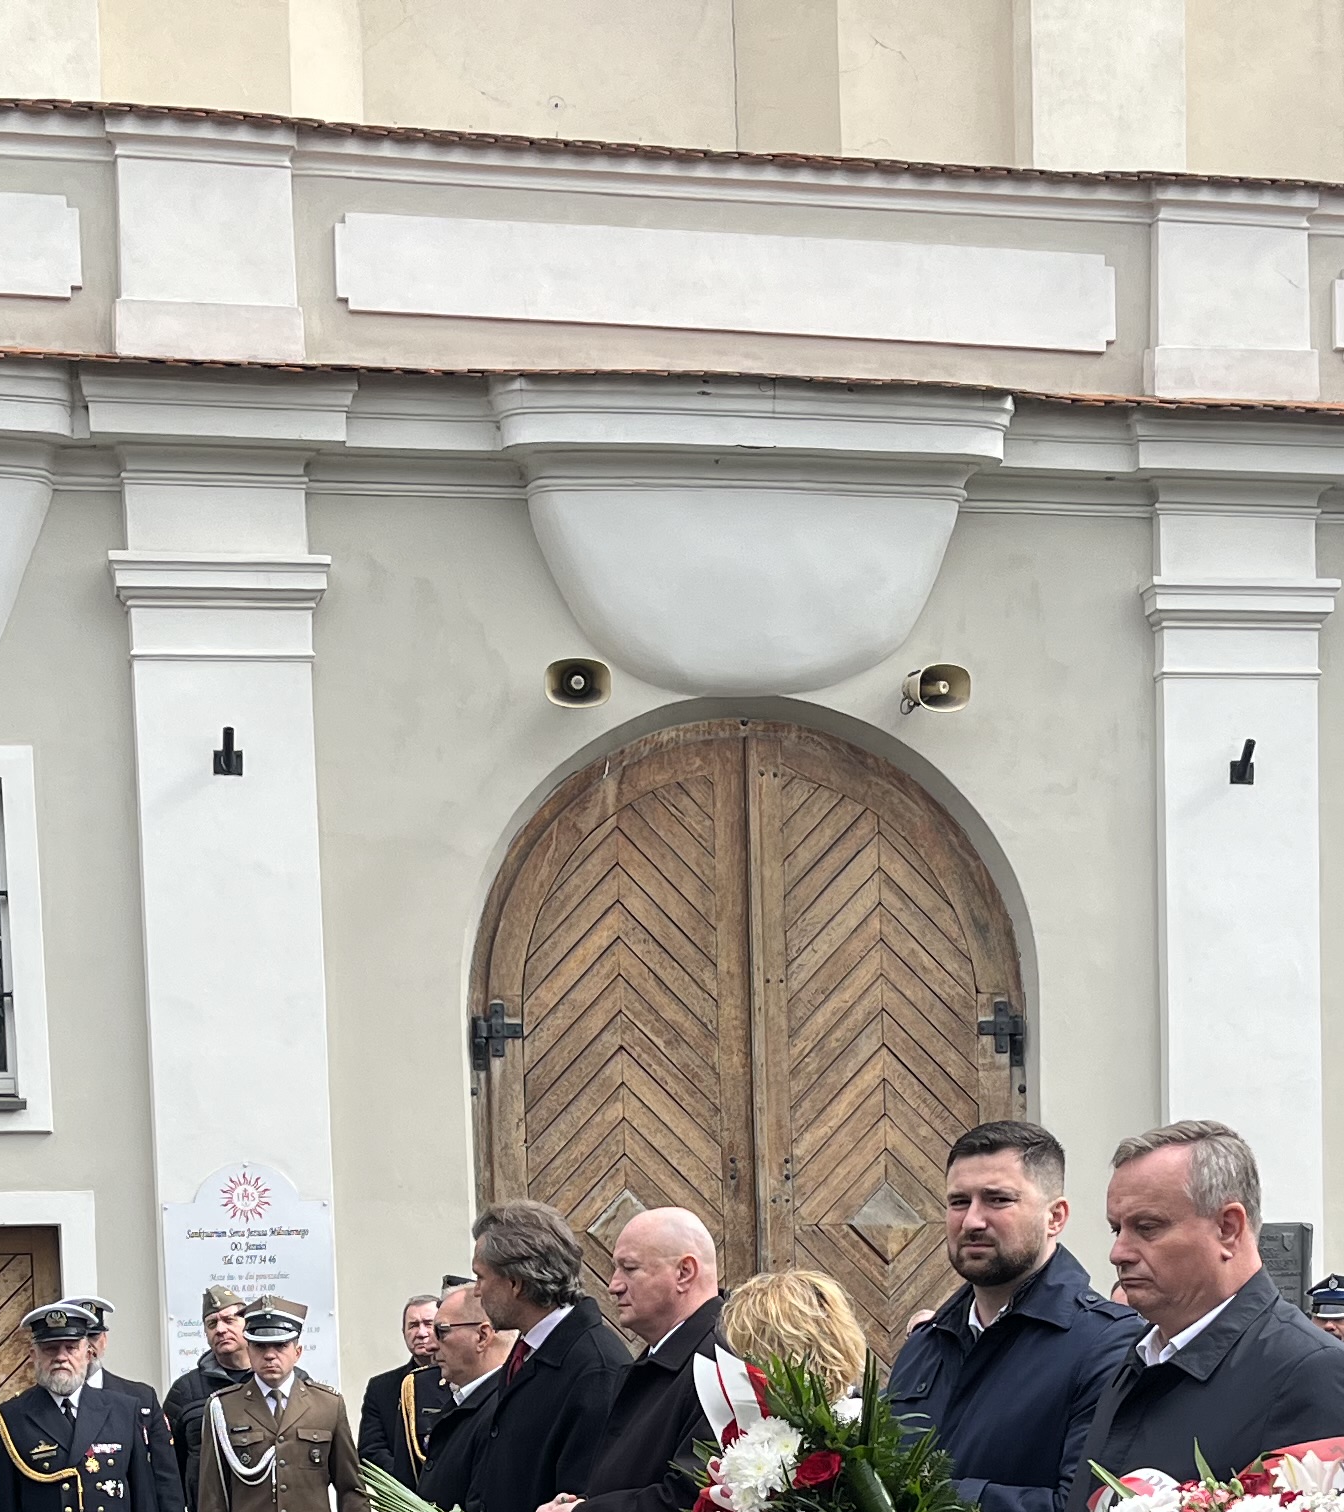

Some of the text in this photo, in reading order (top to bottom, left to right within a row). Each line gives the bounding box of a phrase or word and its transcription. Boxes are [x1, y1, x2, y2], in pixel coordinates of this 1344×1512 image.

[237, 1191, 256, 1201] IHS
[235, 1255, 244, 1265] 62
[245, 1255, 257, 1265] 757
[258, 1255, 267, 1265] 34
